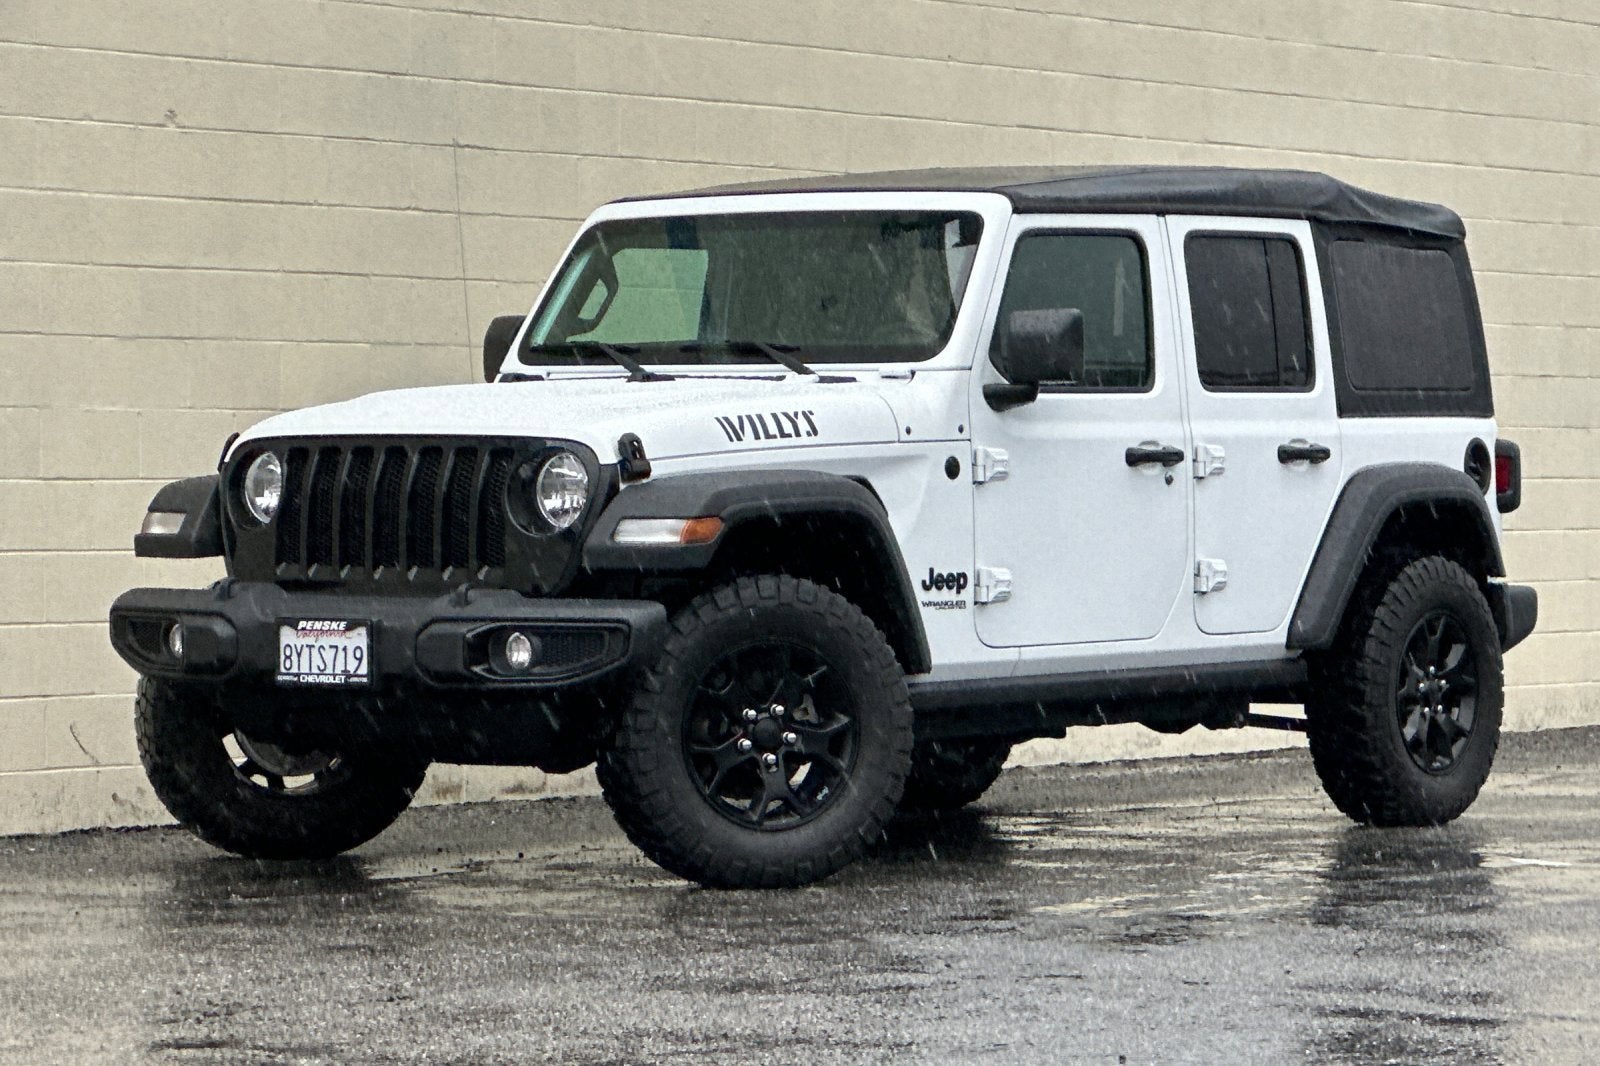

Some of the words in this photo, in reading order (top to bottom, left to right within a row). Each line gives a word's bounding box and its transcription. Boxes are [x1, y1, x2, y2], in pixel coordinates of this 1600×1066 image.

[714, 410, 818, 442] WILLYS
[921, 567, 968, 595] Jeep
[297, 621, 347, 630] PENSKE
[283, 644, 364, 673] 8YTS719
[300, 675, 346, 683] CHEVROLET
